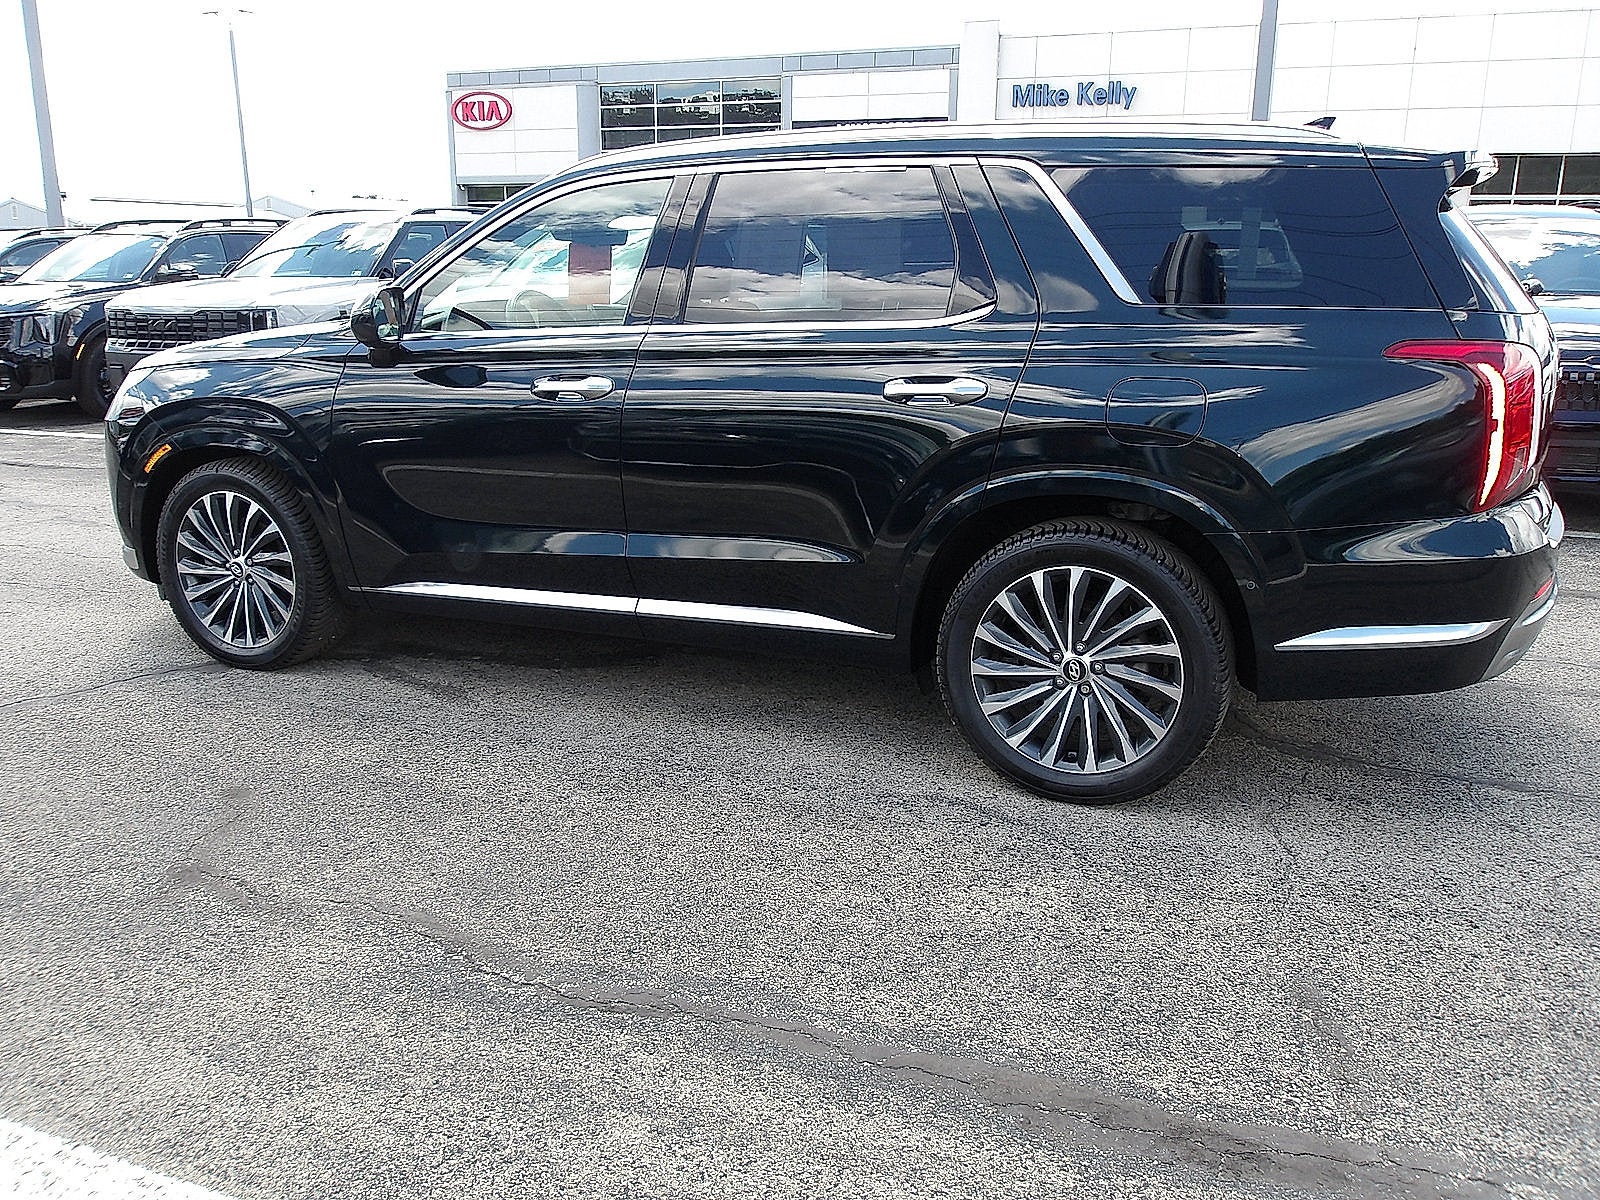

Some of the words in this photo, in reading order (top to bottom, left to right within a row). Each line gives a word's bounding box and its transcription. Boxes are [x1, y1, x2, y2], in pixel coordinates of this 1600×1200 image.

[1012, 84, 1069, 108] Mike
[1076, 81, 1137, 110] Kelly
[462, 100, 503, 122] KIA
